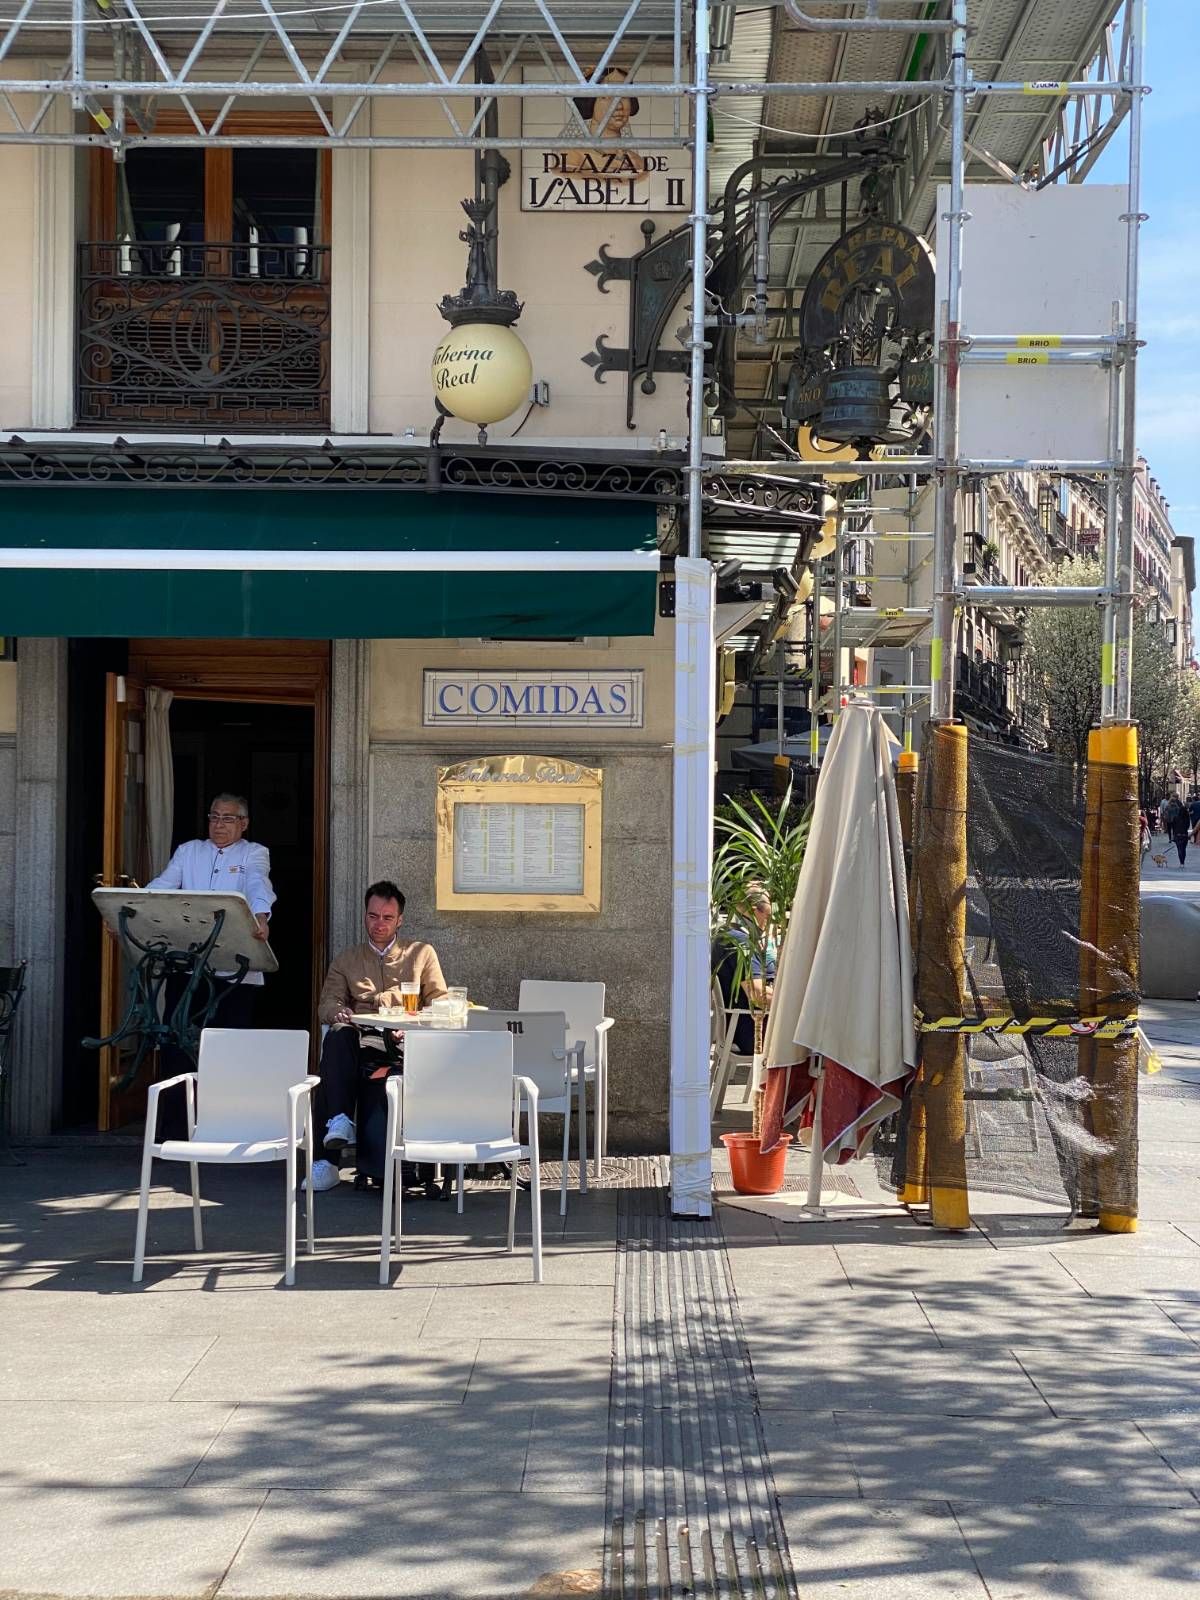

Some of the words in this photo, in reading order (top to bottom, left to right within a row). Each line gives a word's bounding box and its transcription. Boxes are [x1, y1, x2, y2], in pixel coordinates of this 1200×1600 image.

[542, 152, 638, 174] PLAZA
[643, 156, 670, 172] DE
[529, 177, 649, 208] ISABEL
[665, 178, 686, 206] II
[820, 246, 918, 314] REAL
[436, 363, 478, 390] Real
[438, 683, 628, 714] COMIDAS
